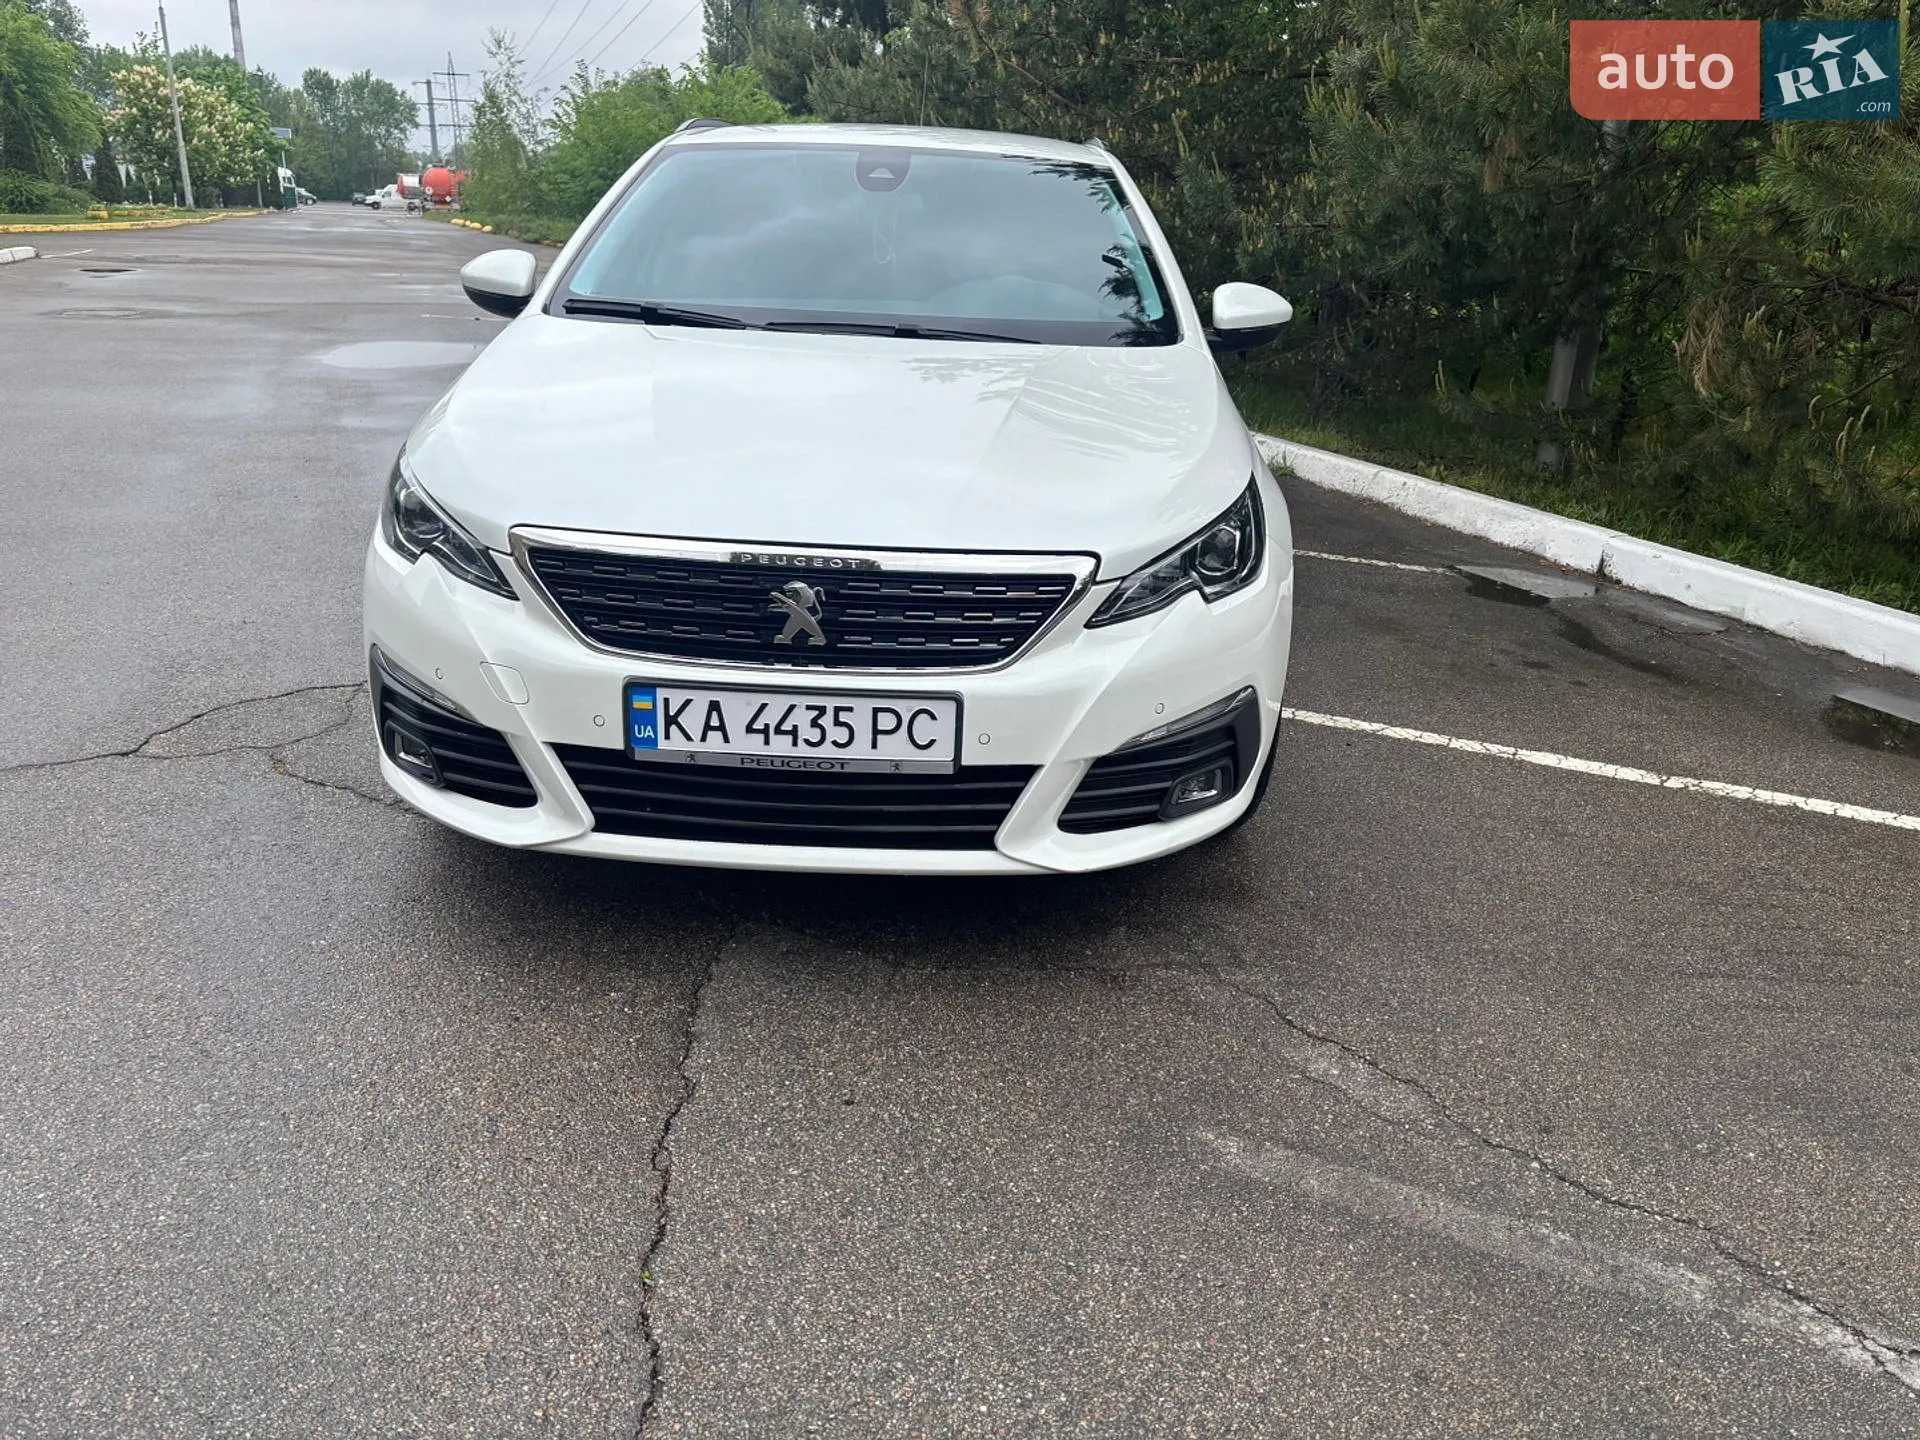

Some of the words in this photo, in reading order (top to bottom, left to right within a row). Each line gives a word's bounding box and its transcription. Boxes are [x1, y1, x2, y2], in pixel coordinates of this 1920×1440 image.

[741, 553, 860, 568] PEUGEOT
[663, 697, 731, 744] KA
[745, 702, 855, 749] 4435
[870, 706, 938, 750] PC
[634, 724, 655, 738] UA
[740, 757, 849, 771] PEUGEOT
